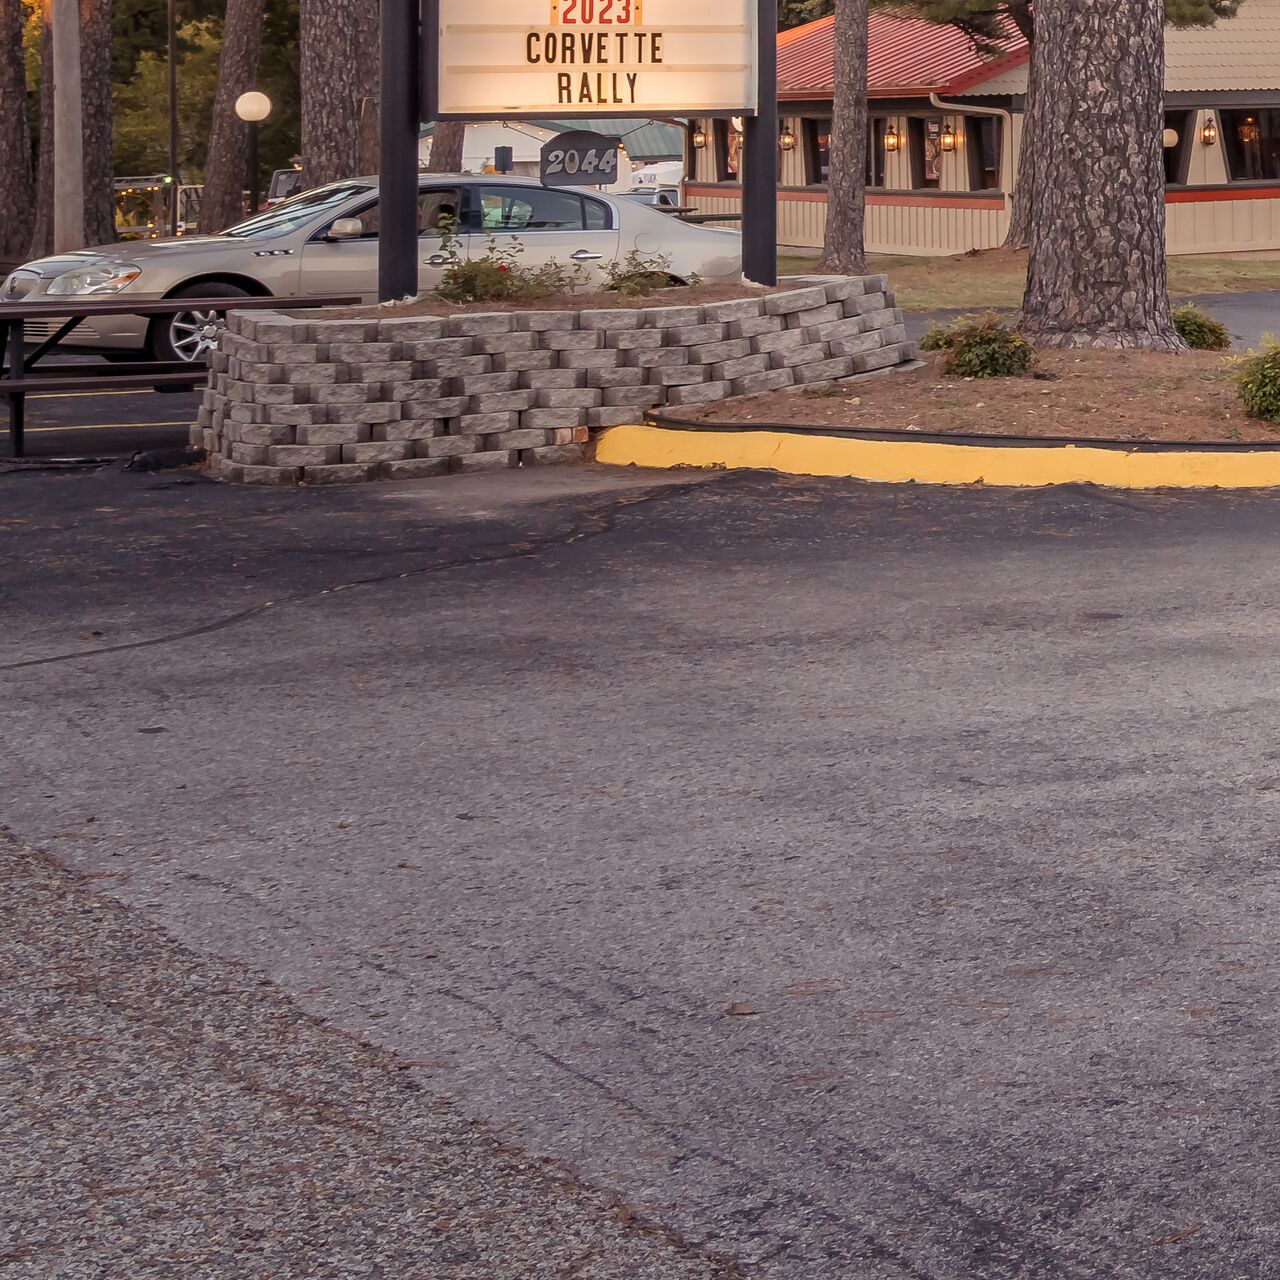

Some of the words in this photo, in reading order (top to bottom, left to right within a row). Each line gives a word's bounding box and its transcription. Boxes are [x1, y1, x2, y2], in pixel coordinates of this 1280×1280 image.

[526, 32, 663, 64] CORVETTE
[557, 72, 637, 104] RALLY
[545, 148, 617, 175] 2044
